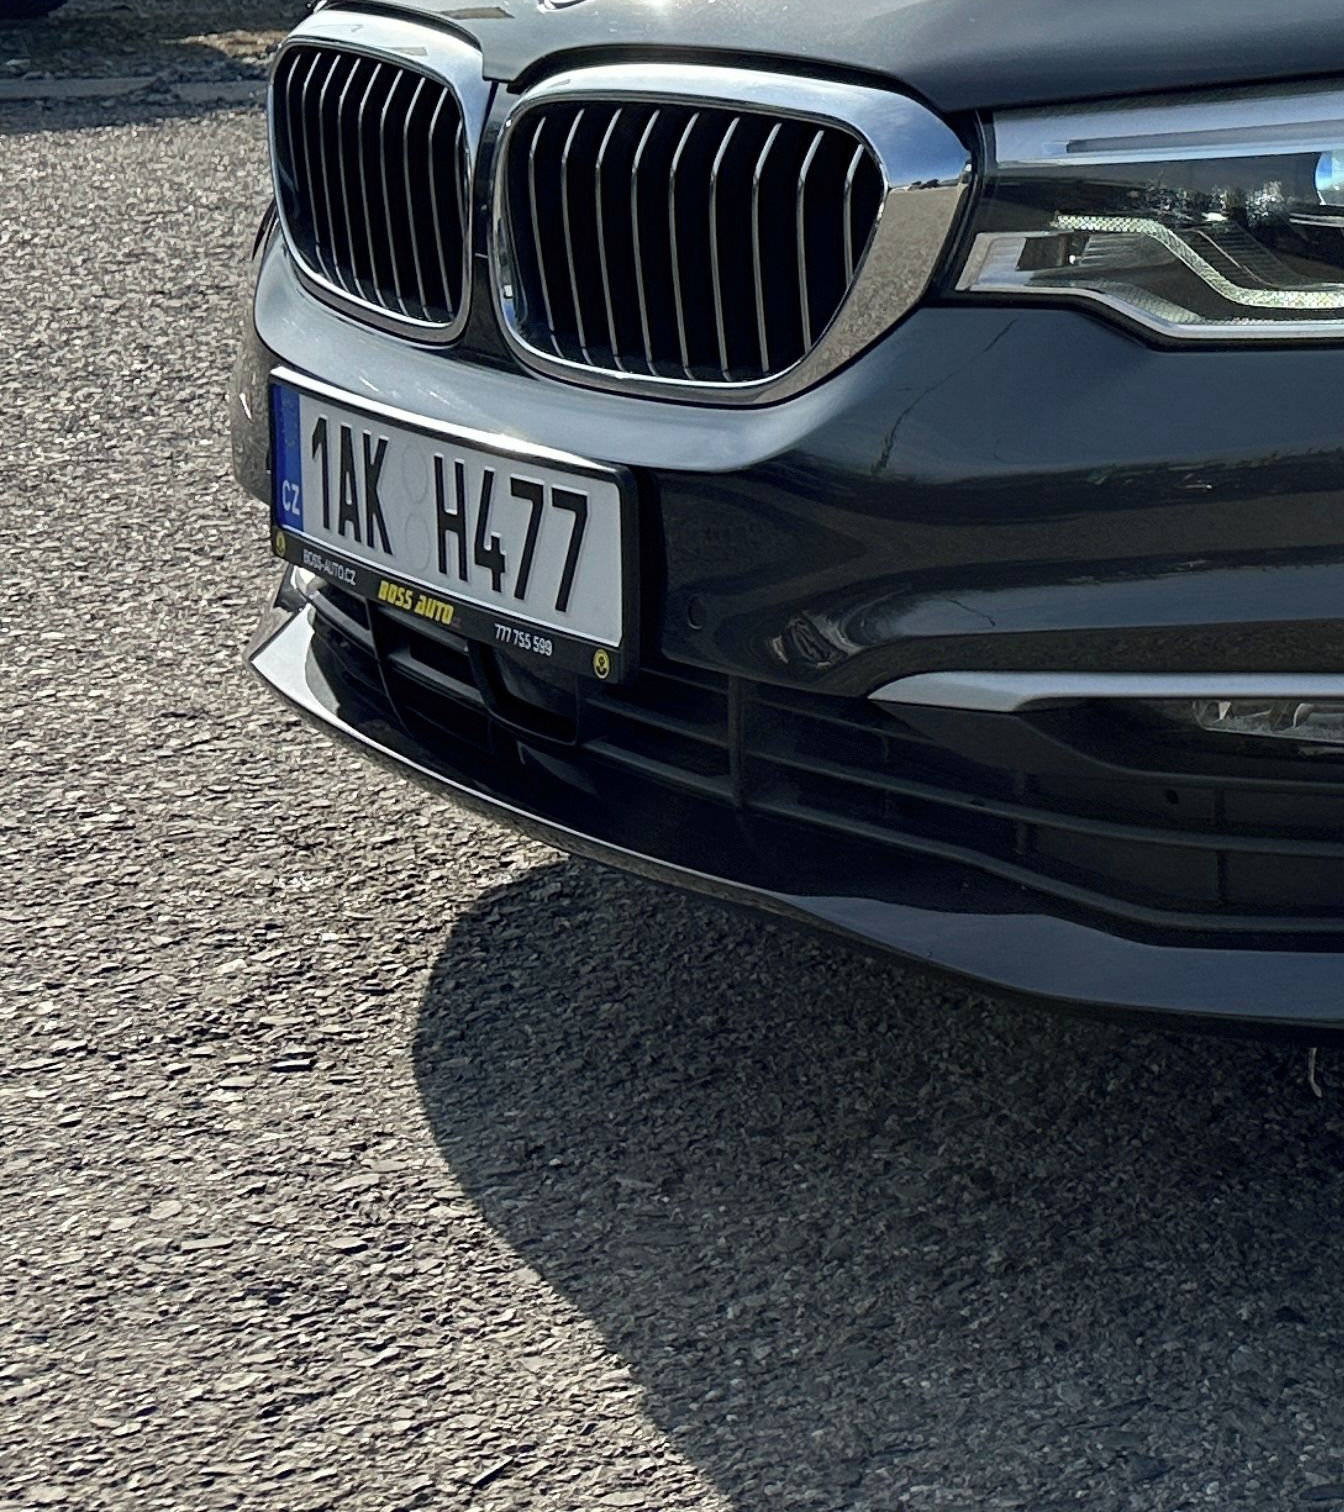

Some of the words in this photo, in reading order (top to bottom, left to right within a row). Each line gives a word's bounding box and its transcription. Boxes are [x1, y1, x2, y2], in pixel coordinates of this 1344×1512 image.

[281, 480, 301, 516] CZ
[311, 417, 394, 556] 1AK
[434, 454, 588, 614] H477
[303, 548, 357, 586] BOSS-AUTO.CZ
[377, 580, 414, 610] BOSS
[494, 623, 512, 643] 777
[513, 629, 532, 651] 755
[533, 637, 553, 657] 599
